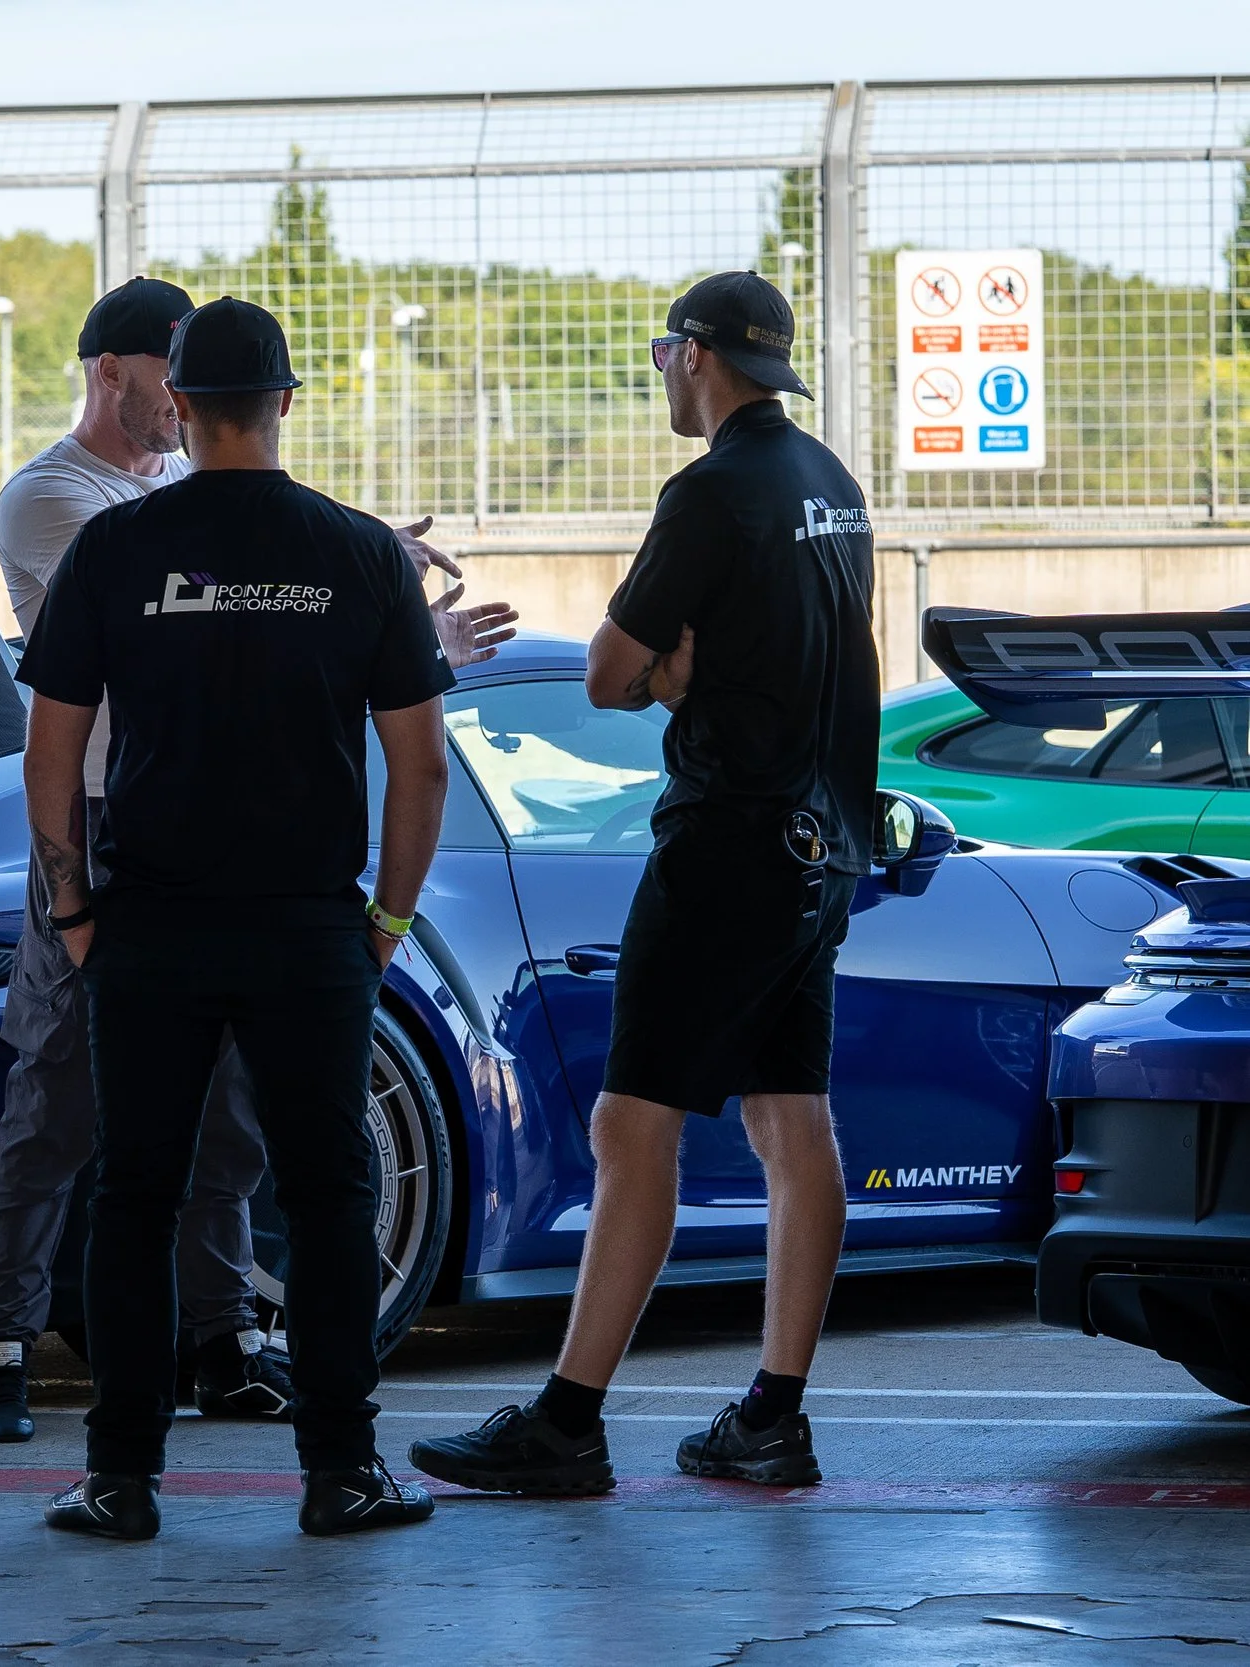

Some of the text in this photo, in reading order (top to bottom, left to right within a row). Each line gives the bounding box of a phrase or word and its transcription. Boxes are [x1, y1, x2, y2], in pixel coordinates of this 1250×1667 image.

[830, 508, 858, 521] POINT
[217, 584, 332, 600] POINT ZERO
[214, 598, 331, 614] MOTORSPORT
[367, 1105, 394, 1247] PORSCH
[896, 1164, 1022, 1188] MANTHEY
